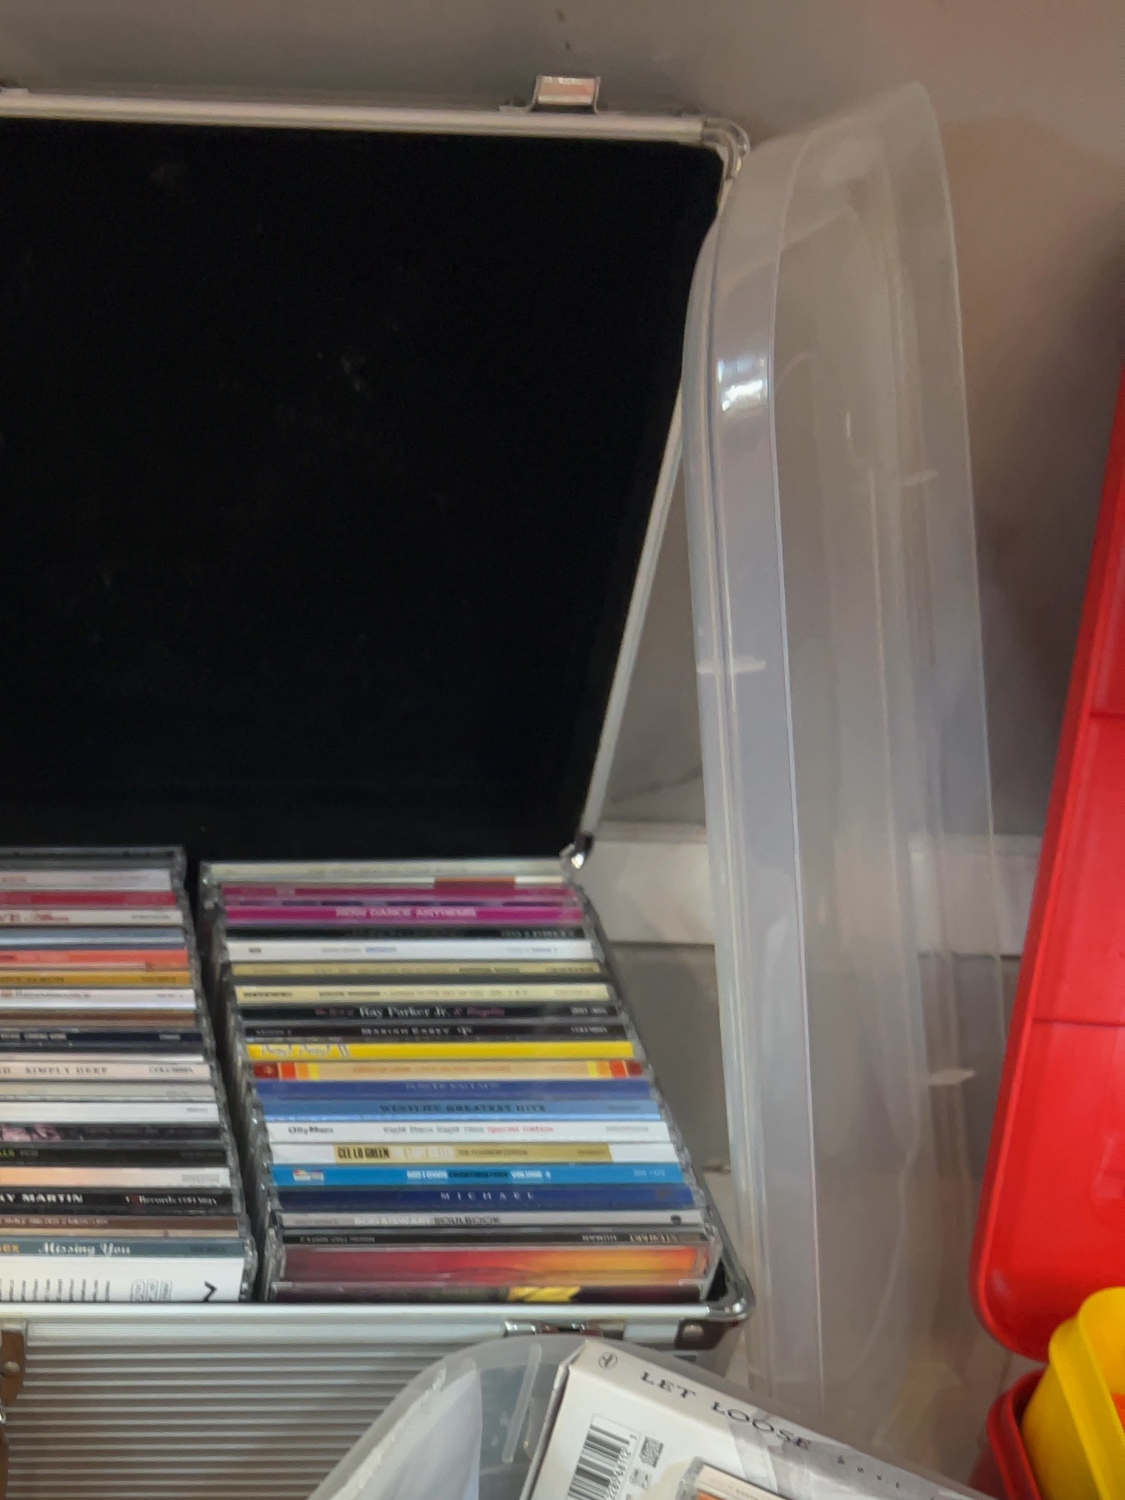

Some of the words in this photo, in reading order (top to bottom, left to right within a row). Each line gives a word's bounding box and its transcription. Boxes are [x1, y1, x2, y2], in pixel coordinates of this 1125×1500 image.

[359, 1006, 384, 1019] Ray
[387, 1006, 430, 1018] Parker
[22, 1193, 83, 1203] MARTIN
[100, 1242, 131, 1255] You
[639, 1369, 697, 1403] LET
[709, 1397, 813, 1453] LOOSE
